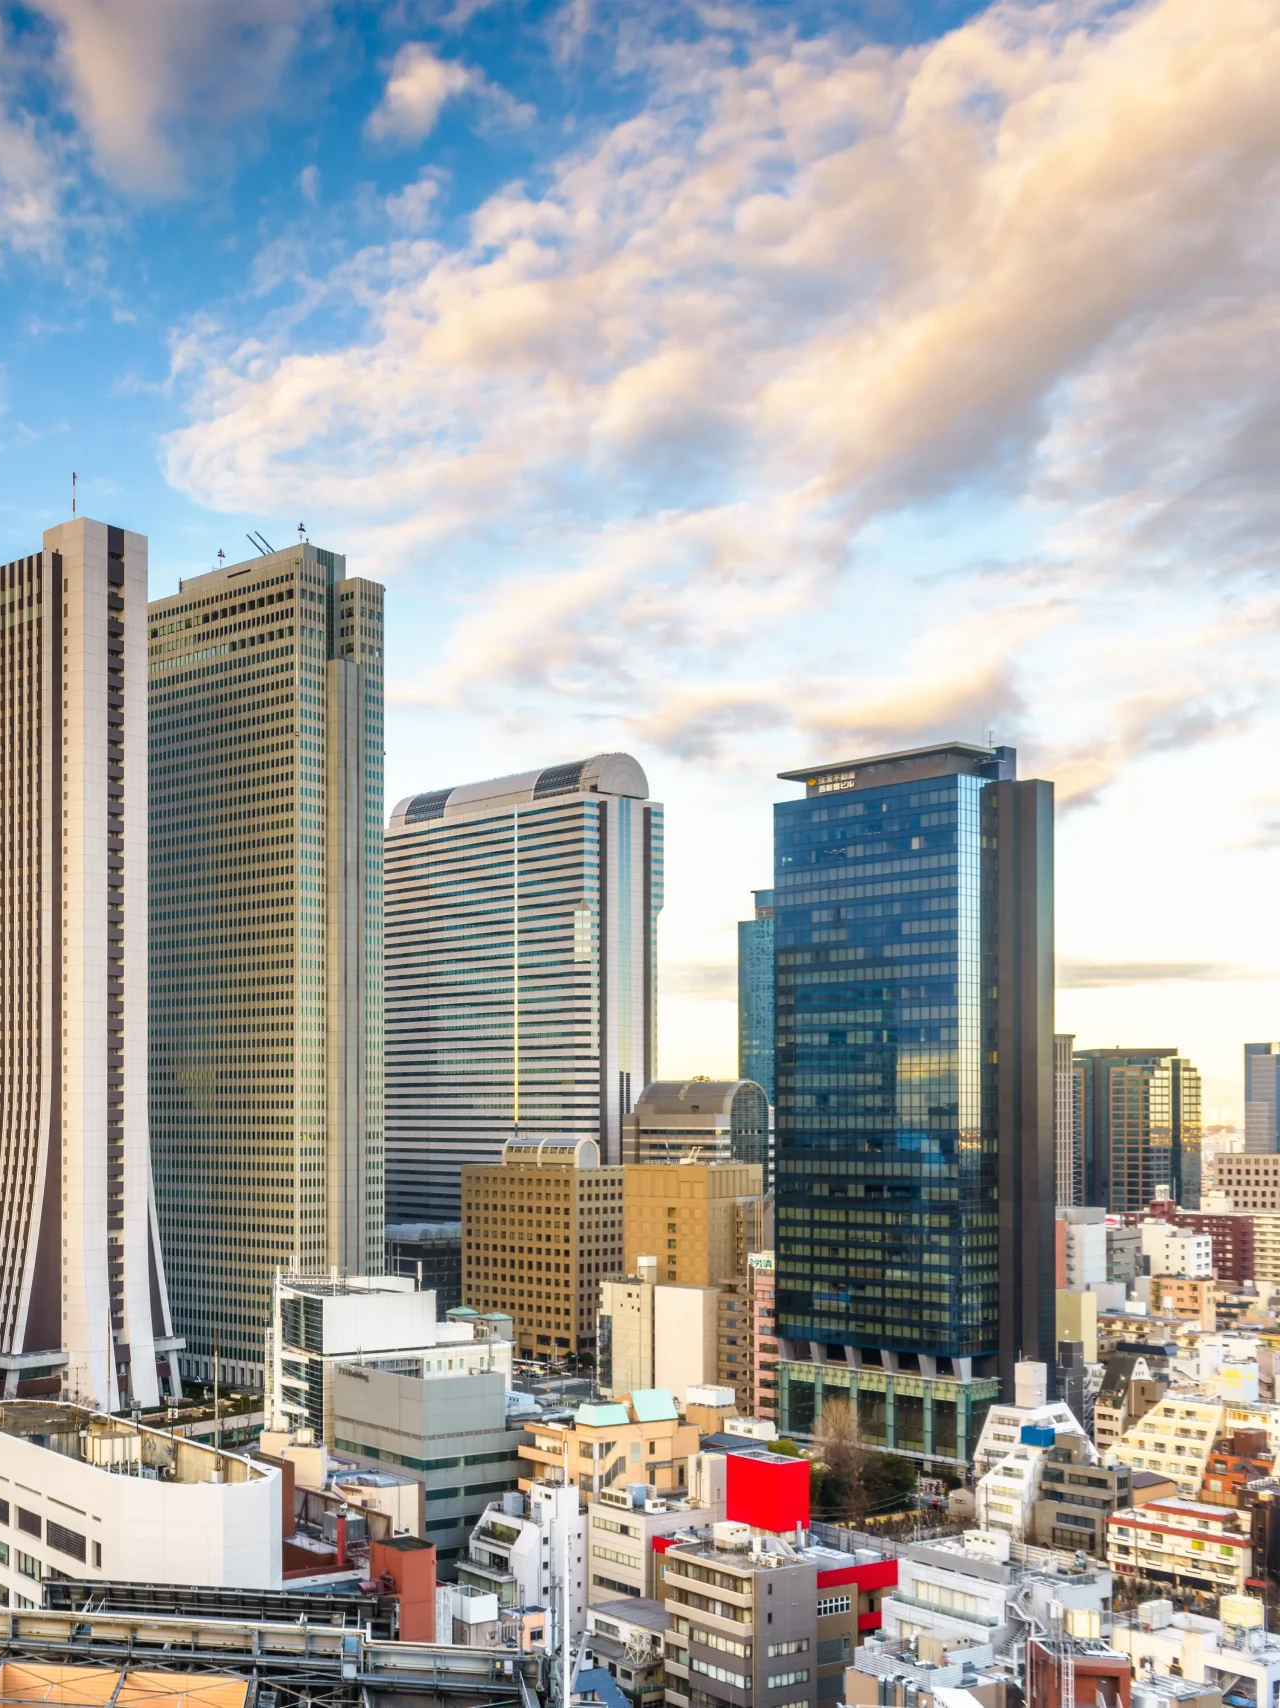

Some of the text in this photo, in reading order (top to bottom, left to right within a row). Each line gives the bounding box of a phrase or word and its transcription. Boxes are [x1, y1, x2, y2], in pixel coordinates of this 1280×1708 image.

[819, 780, 855, 793] 西新宿ビル
